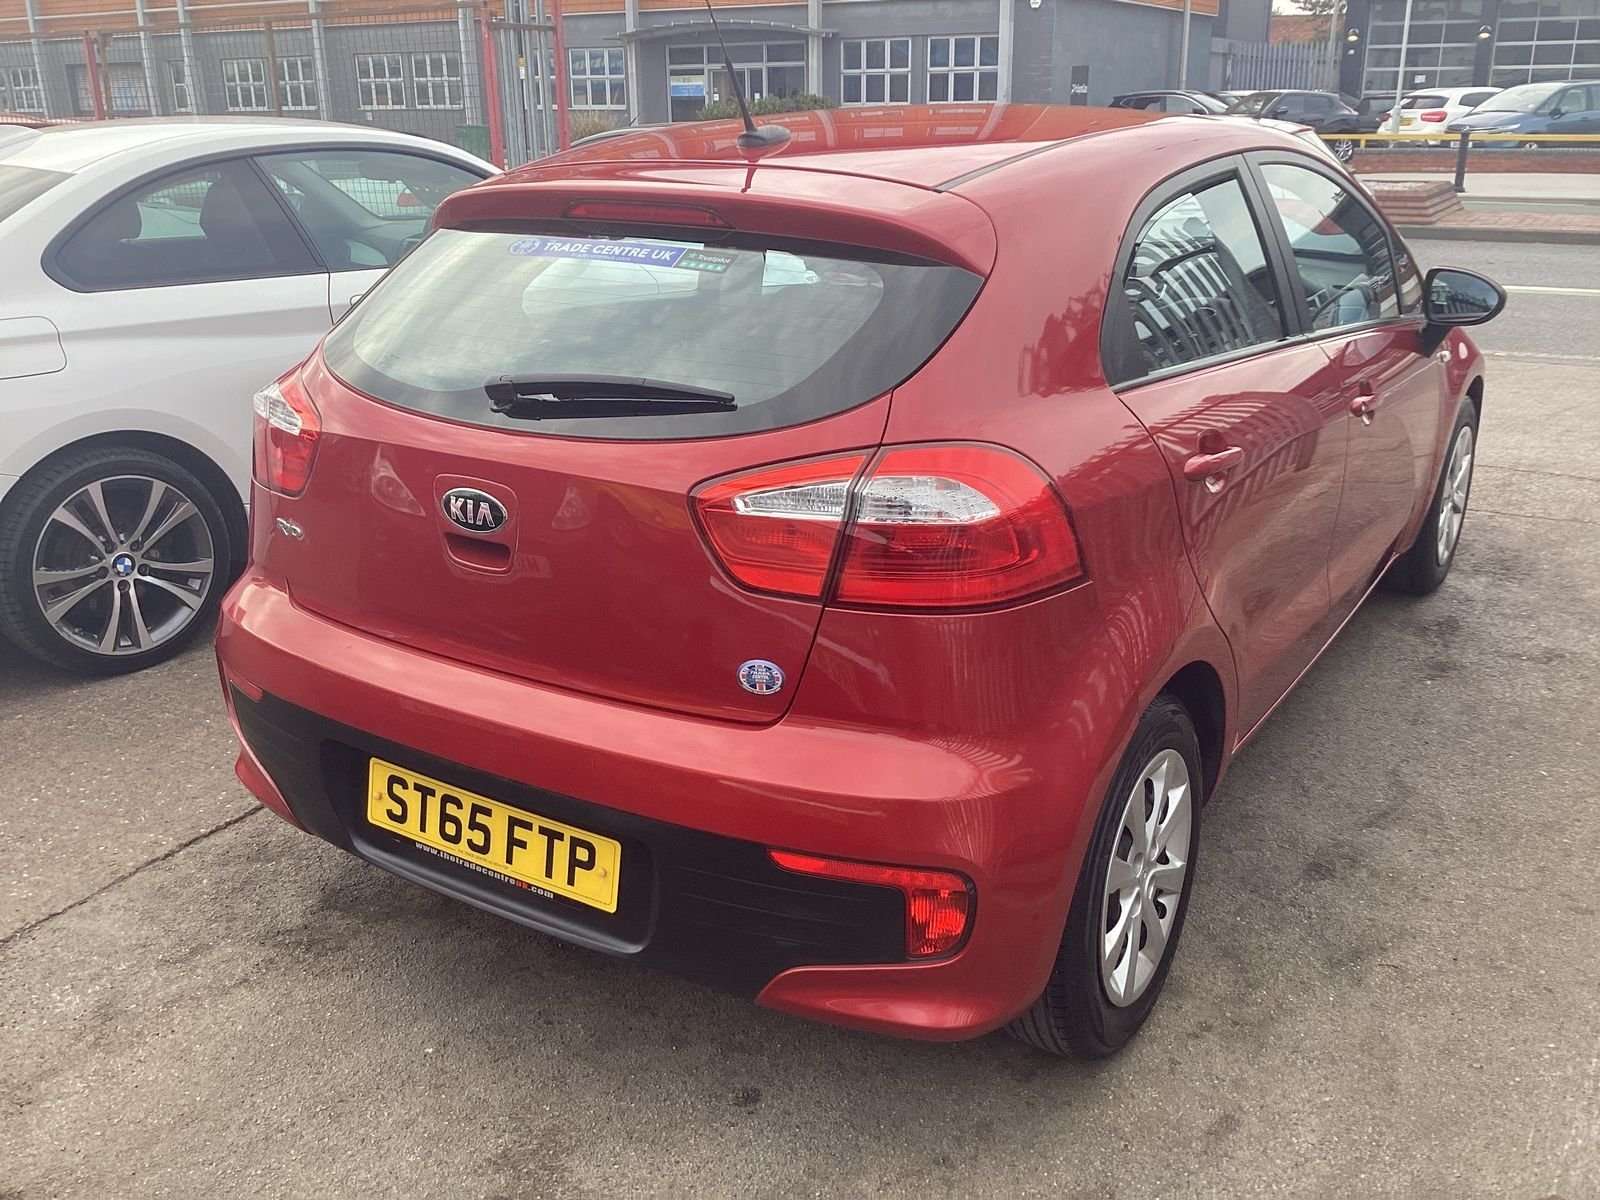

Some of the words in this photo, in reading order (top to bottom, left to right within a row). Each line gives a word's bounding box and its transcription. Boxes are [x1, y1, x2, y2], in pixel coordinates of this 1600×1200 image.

[543, 241, 592, 254] TRADE
[592, 244, 651, 258] CENTRE
[651, 248, 677, 261] UK
[449, 495, 496, 528] KIA
[385, 773, 493, 856] ST65
[505, 814, 597, 887] FTP
